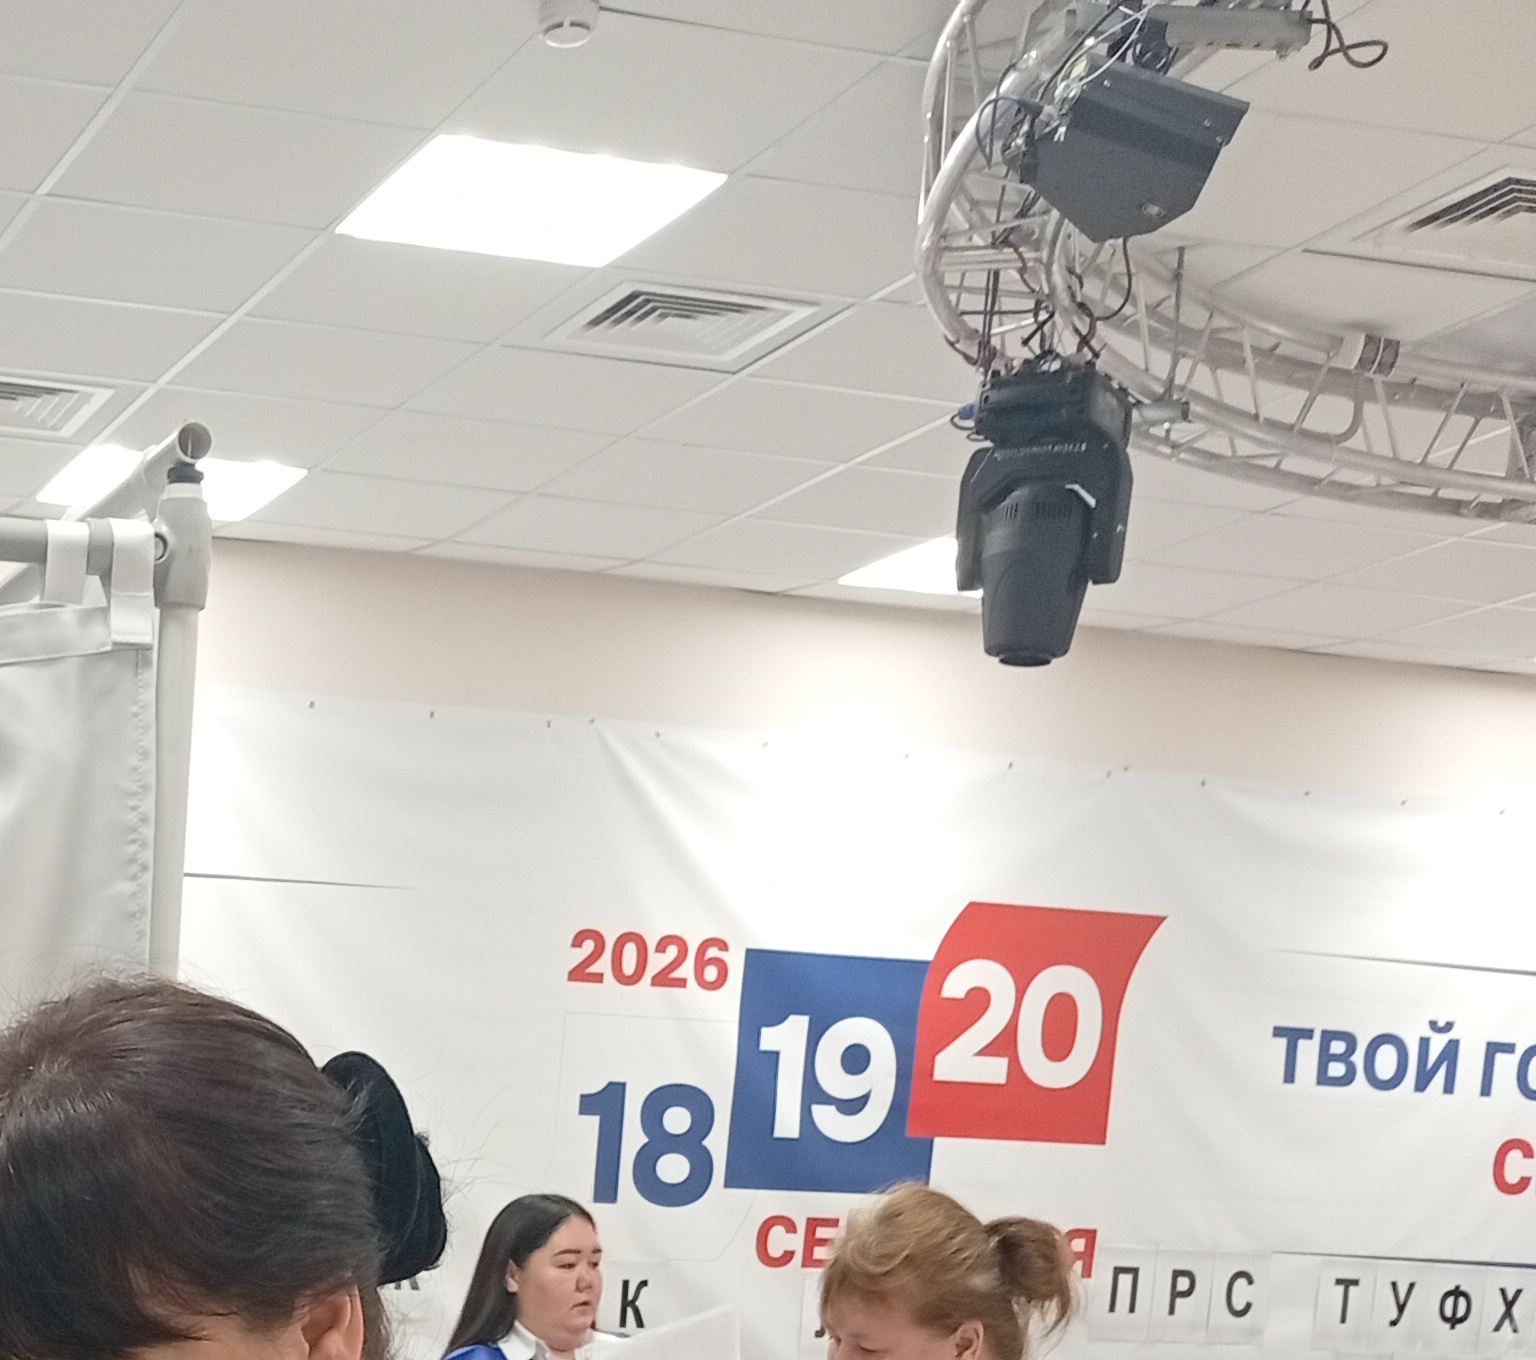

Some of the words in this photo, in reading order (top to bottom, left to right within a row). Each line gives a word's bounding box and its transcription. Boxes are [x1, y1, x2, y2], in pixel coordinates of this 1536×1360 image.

[567, 928, 730, 991] 2026
[578, 1081, 715, 1208] 18
[758, 1014, 897, 1143] 19
[932, 958, 1103, 1089] 20
[1272, 1019, 1461, 1095] ТВОЙ
[619, 1279, 648, 1328] К
[1108, 1266, 1140, 1313] П
[1168, 1269, 1196, 1315] Р
[1226, 1270, 1254, 1318] С
[1334, 1278, 1360, 1324] Т
[1389, 1281, 1416, 1327] У
[1439, 1285, 1472, 1330] Ф
[1492, 1287, 1523, 1334] Х
